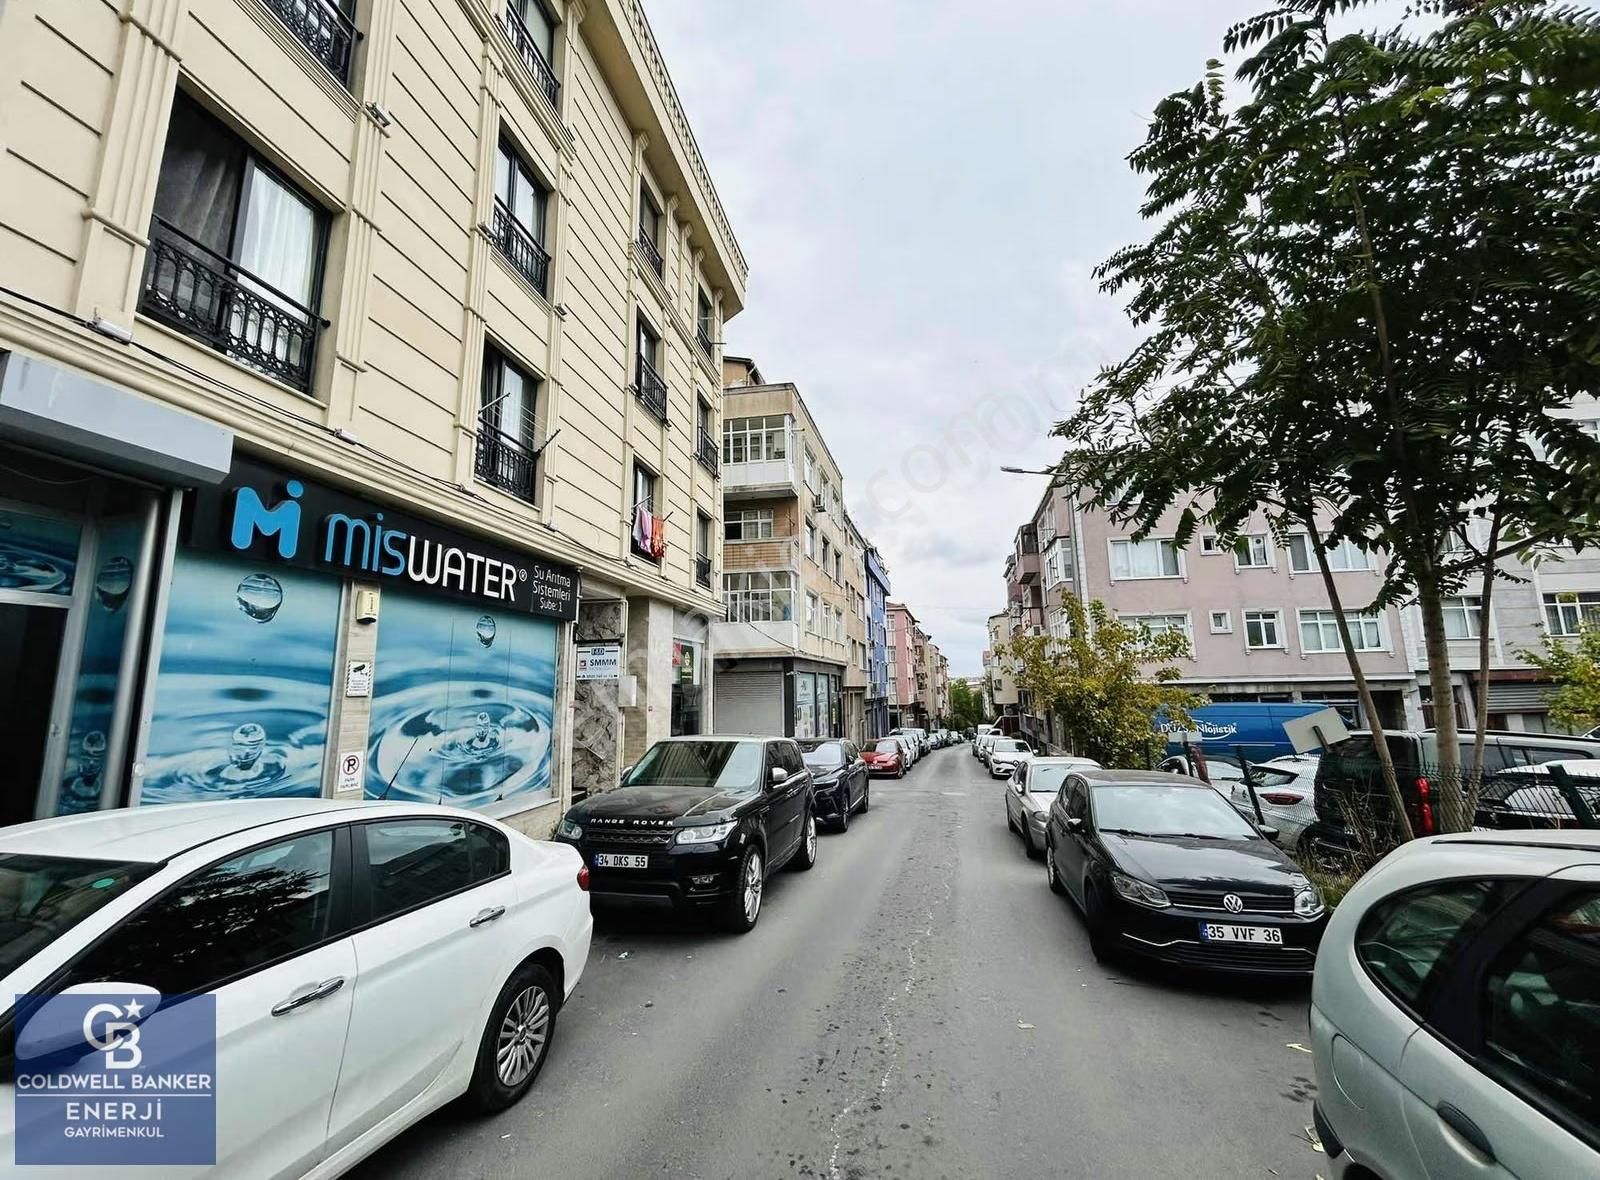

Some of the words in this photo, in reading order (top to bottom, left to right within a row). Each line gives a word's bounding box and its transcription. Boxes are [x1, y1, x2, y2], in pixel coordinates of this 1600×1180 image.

[534, 565, 546, 580] Su
[532, 580, 571, 601] Sistemleri
[558, 600, 563, 612] 1
[599, 855, 608, 865] 34
[613, 855, 629, 866] DKS
[634, 857, 646, 867] 55
[1209, 926, 1225, 939] 35
[1231, 927, 1256, 941] VVF
[1263, 929, 1280, 942] 36
